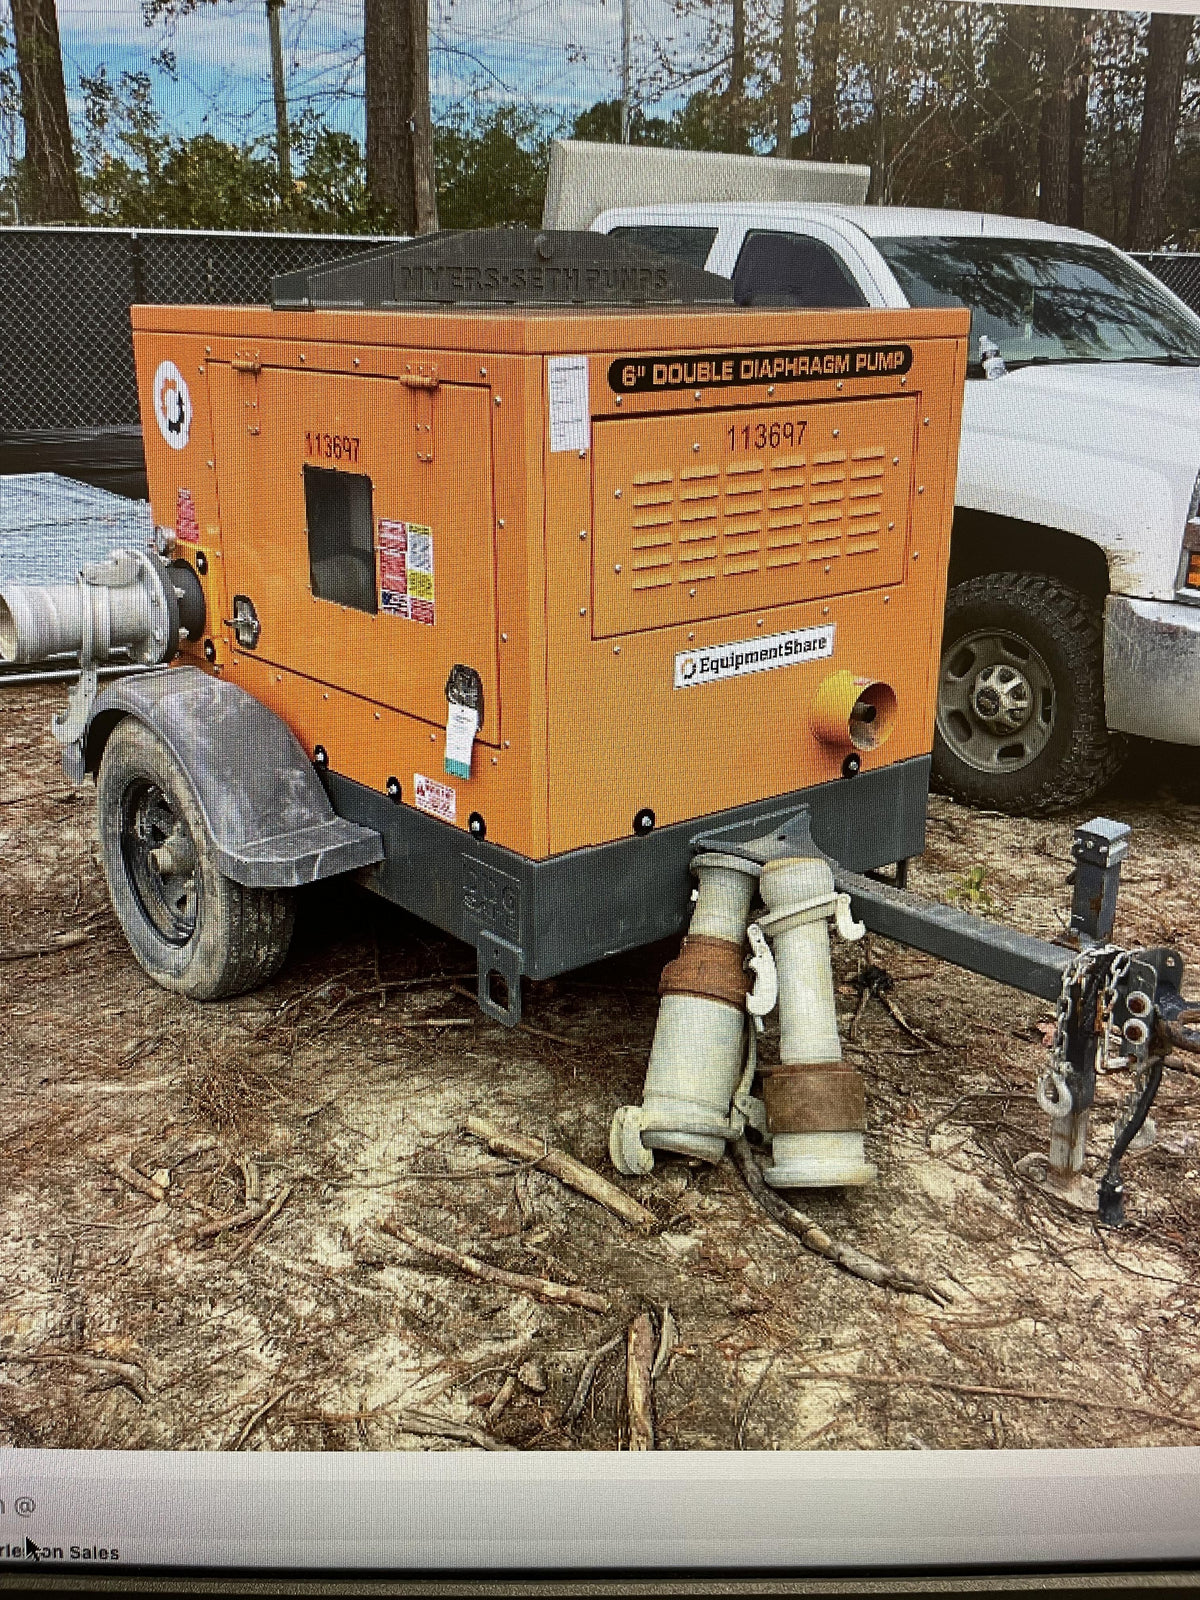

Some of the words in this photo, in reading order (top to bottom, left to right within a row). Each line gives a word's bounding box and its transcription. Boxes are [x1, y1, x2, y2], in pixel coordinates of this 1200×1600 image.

[586, 267, 668, 291] PUMPS
[621, 364, 646, 387] 6"
[652, 359, 735, 386] DOUBLE
[740, 353, 850, 380] DIAPHRAGM
[855, 350, 905, 373] PUMP
[304, 432, 360, 463] 113697
[728, 420, 808, 451] 113697
[699, 636, 827, 674] EquipmentShare
[70, 1545, 119, 1560] Sales
